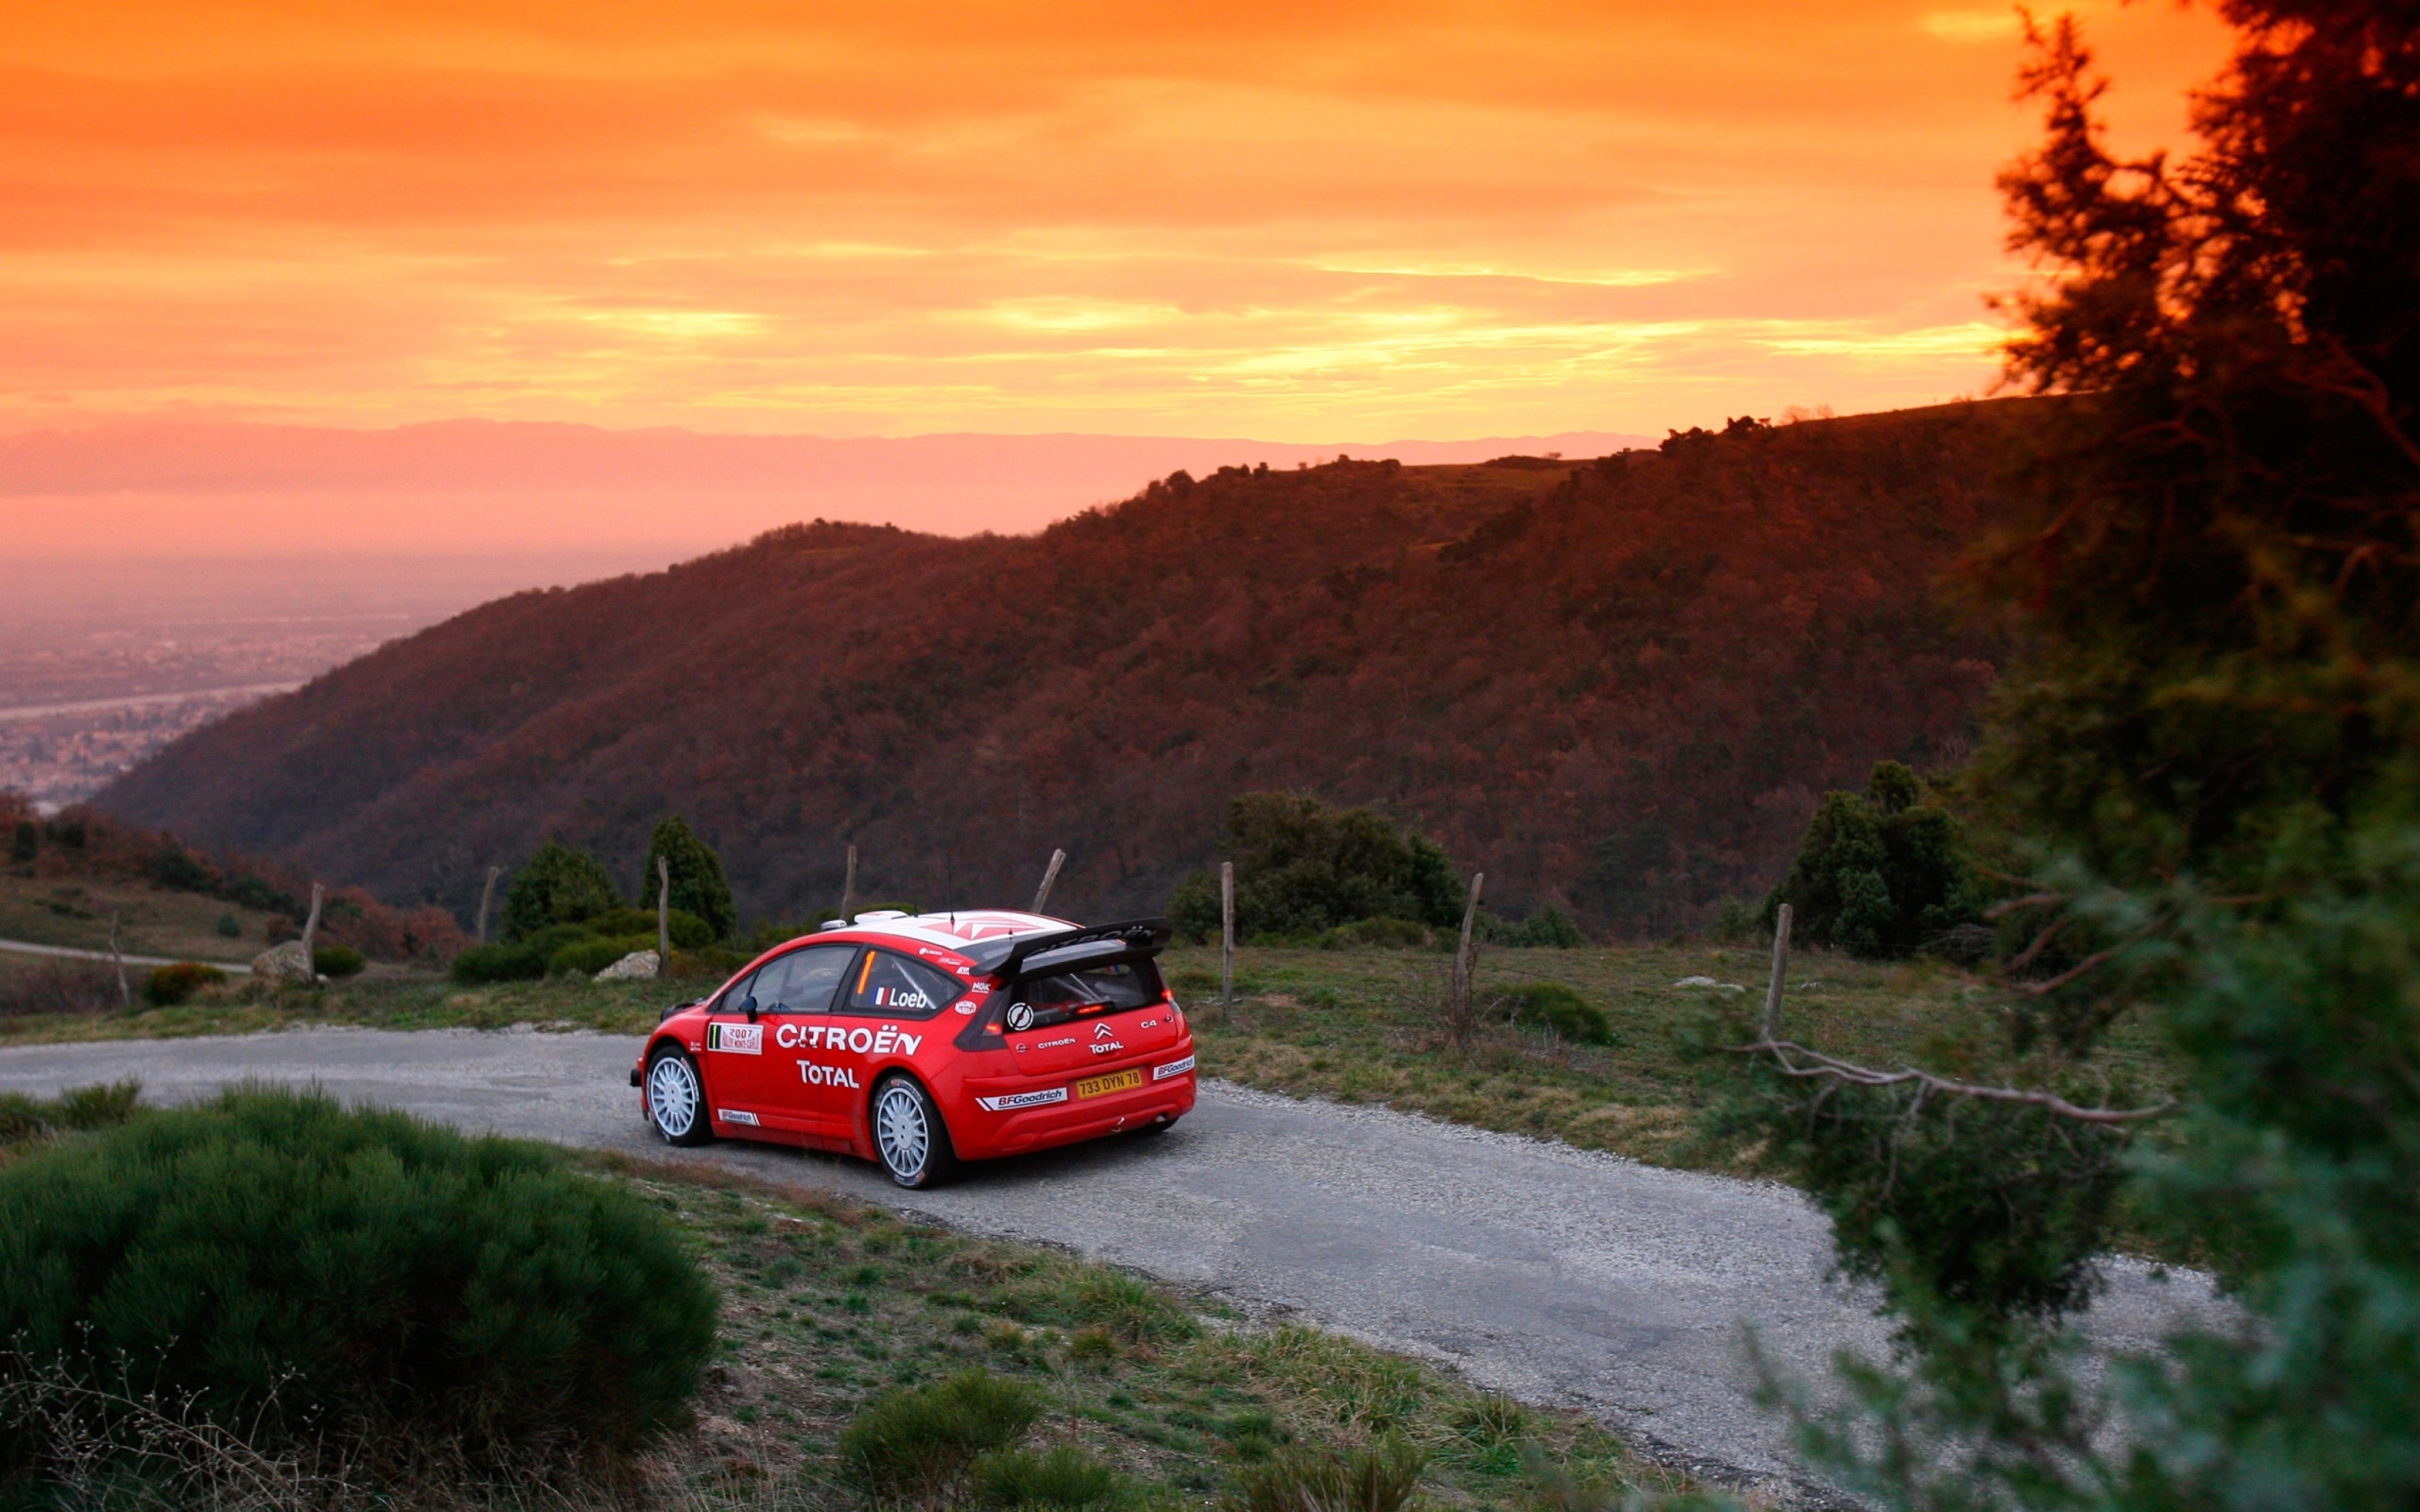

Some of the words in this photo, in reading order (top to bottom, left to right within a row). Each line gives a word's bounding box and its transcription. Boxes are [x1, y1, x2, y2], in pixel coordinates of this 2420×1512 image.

[856, 951, 877, 994] 1
[889, 988, 927, 1008] Loeb
[729, 1028, 753, 1040] 2007
[1140, 1020, 1157, 1029] C4
[775, 1023, 923, 1056] CITROËN
[1088, 1040, 1124, 1055] TOTAL
[796, 1059, 860, 1090] TOTAL
[1079, 1081, 1101, 1096] 733
[1101, 1076, 1125, 1091] DYN
[1125, 1072, 1140, 1086] 78
[997, 1089, 1063, 1107] BFGoodrich
